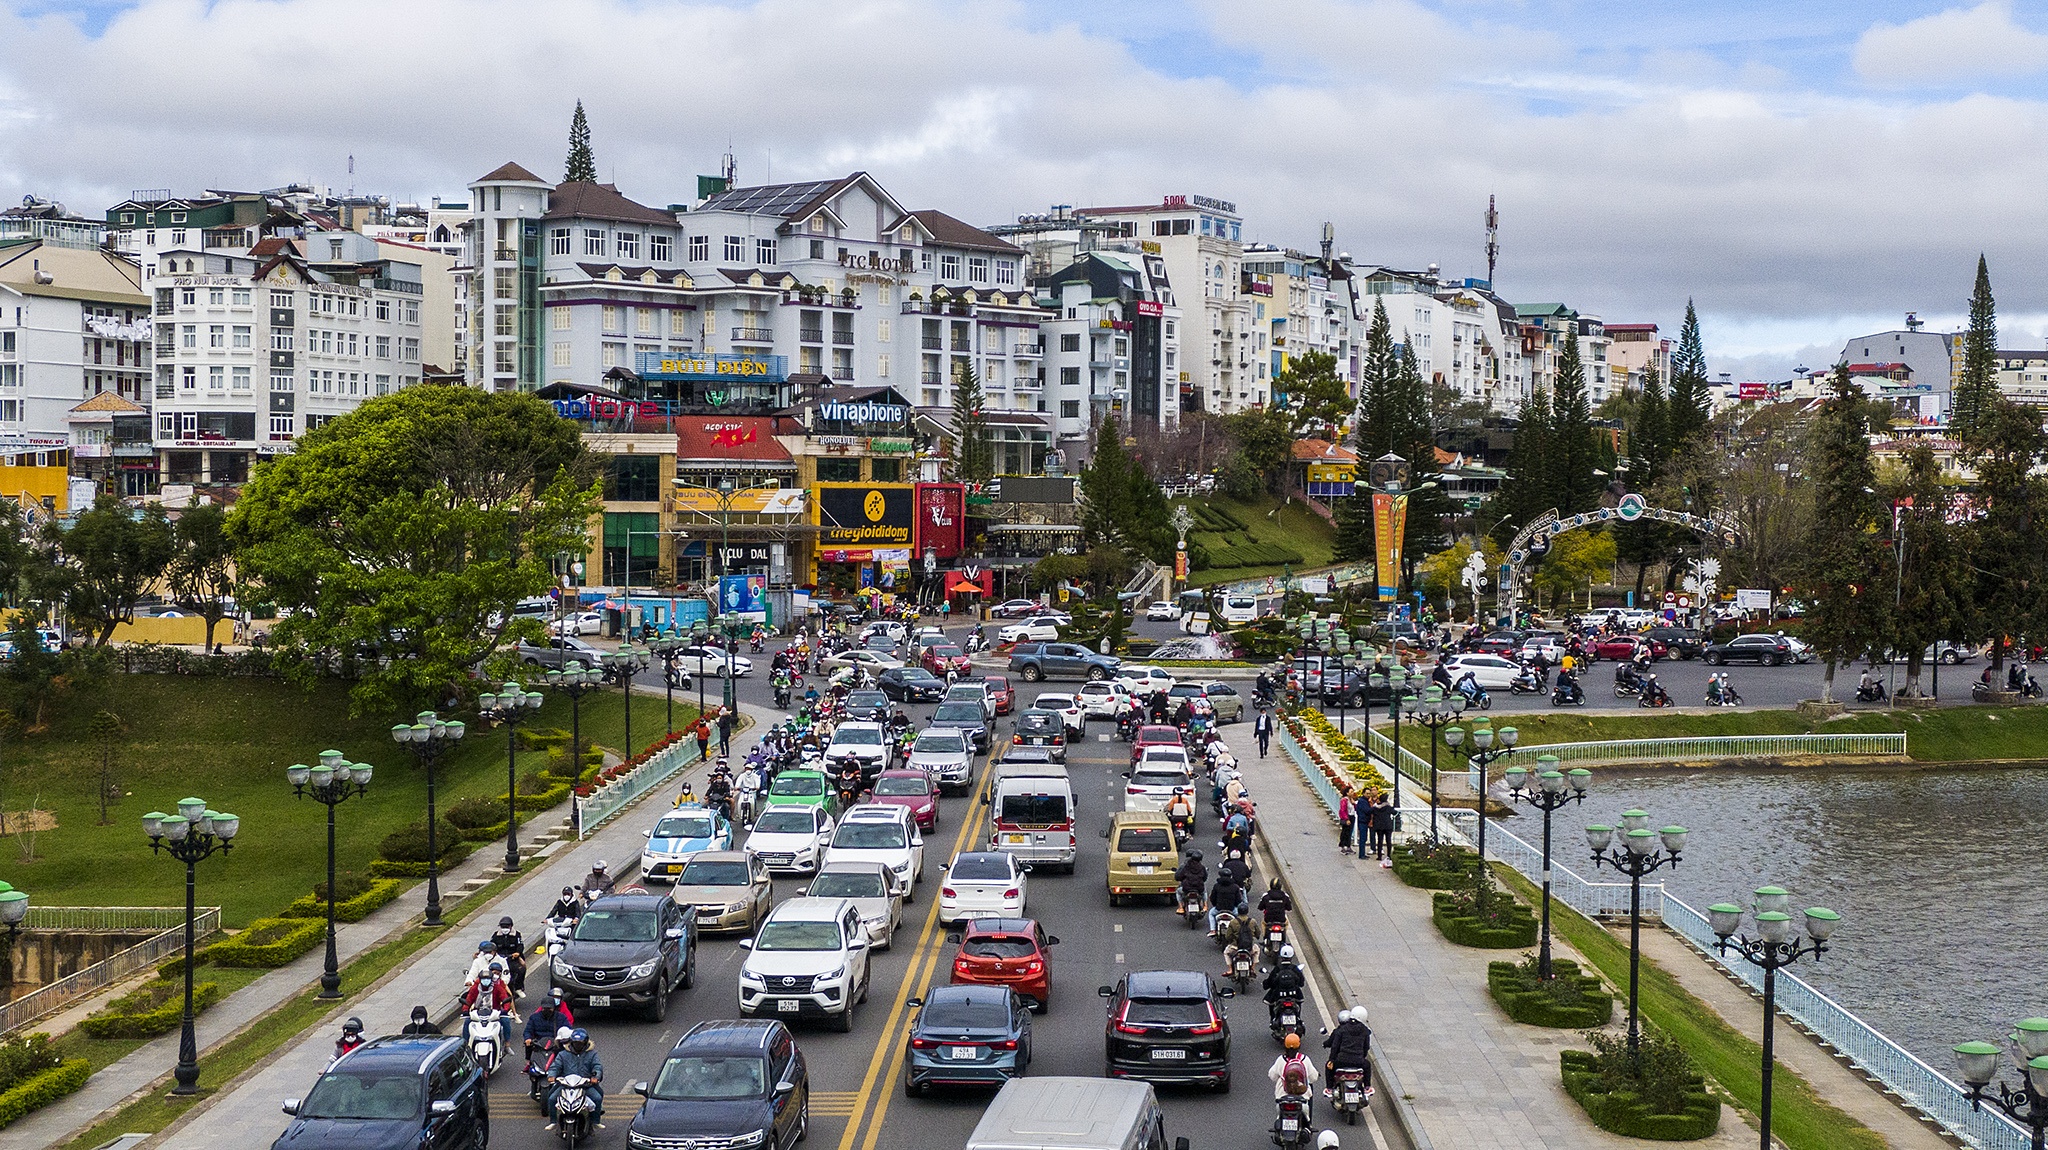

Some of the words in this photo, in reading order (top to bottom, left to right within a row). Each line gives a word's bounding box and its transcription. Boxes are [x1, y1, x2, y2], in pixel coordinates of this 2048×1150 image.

[1163, 195, 1187, 205] 500K
[841, 254, 866, 269] TTC
[871, 256, 918, 274] HOTEL
[174, 277, 192, 286] PHO
[194, 276, 209, 285] NUI
[212, 276, 242, 286] HOTEL
[286, 278, 297, 286] NUI
[661, 358, 707, 373] BƯU
[717, 358, 767, 376] ĐIỆN
[820, 399, 902, 423] vinaphone
[1931, 442, 1962, 450] DREAM
[942, 518, 952, 526] CLUB
